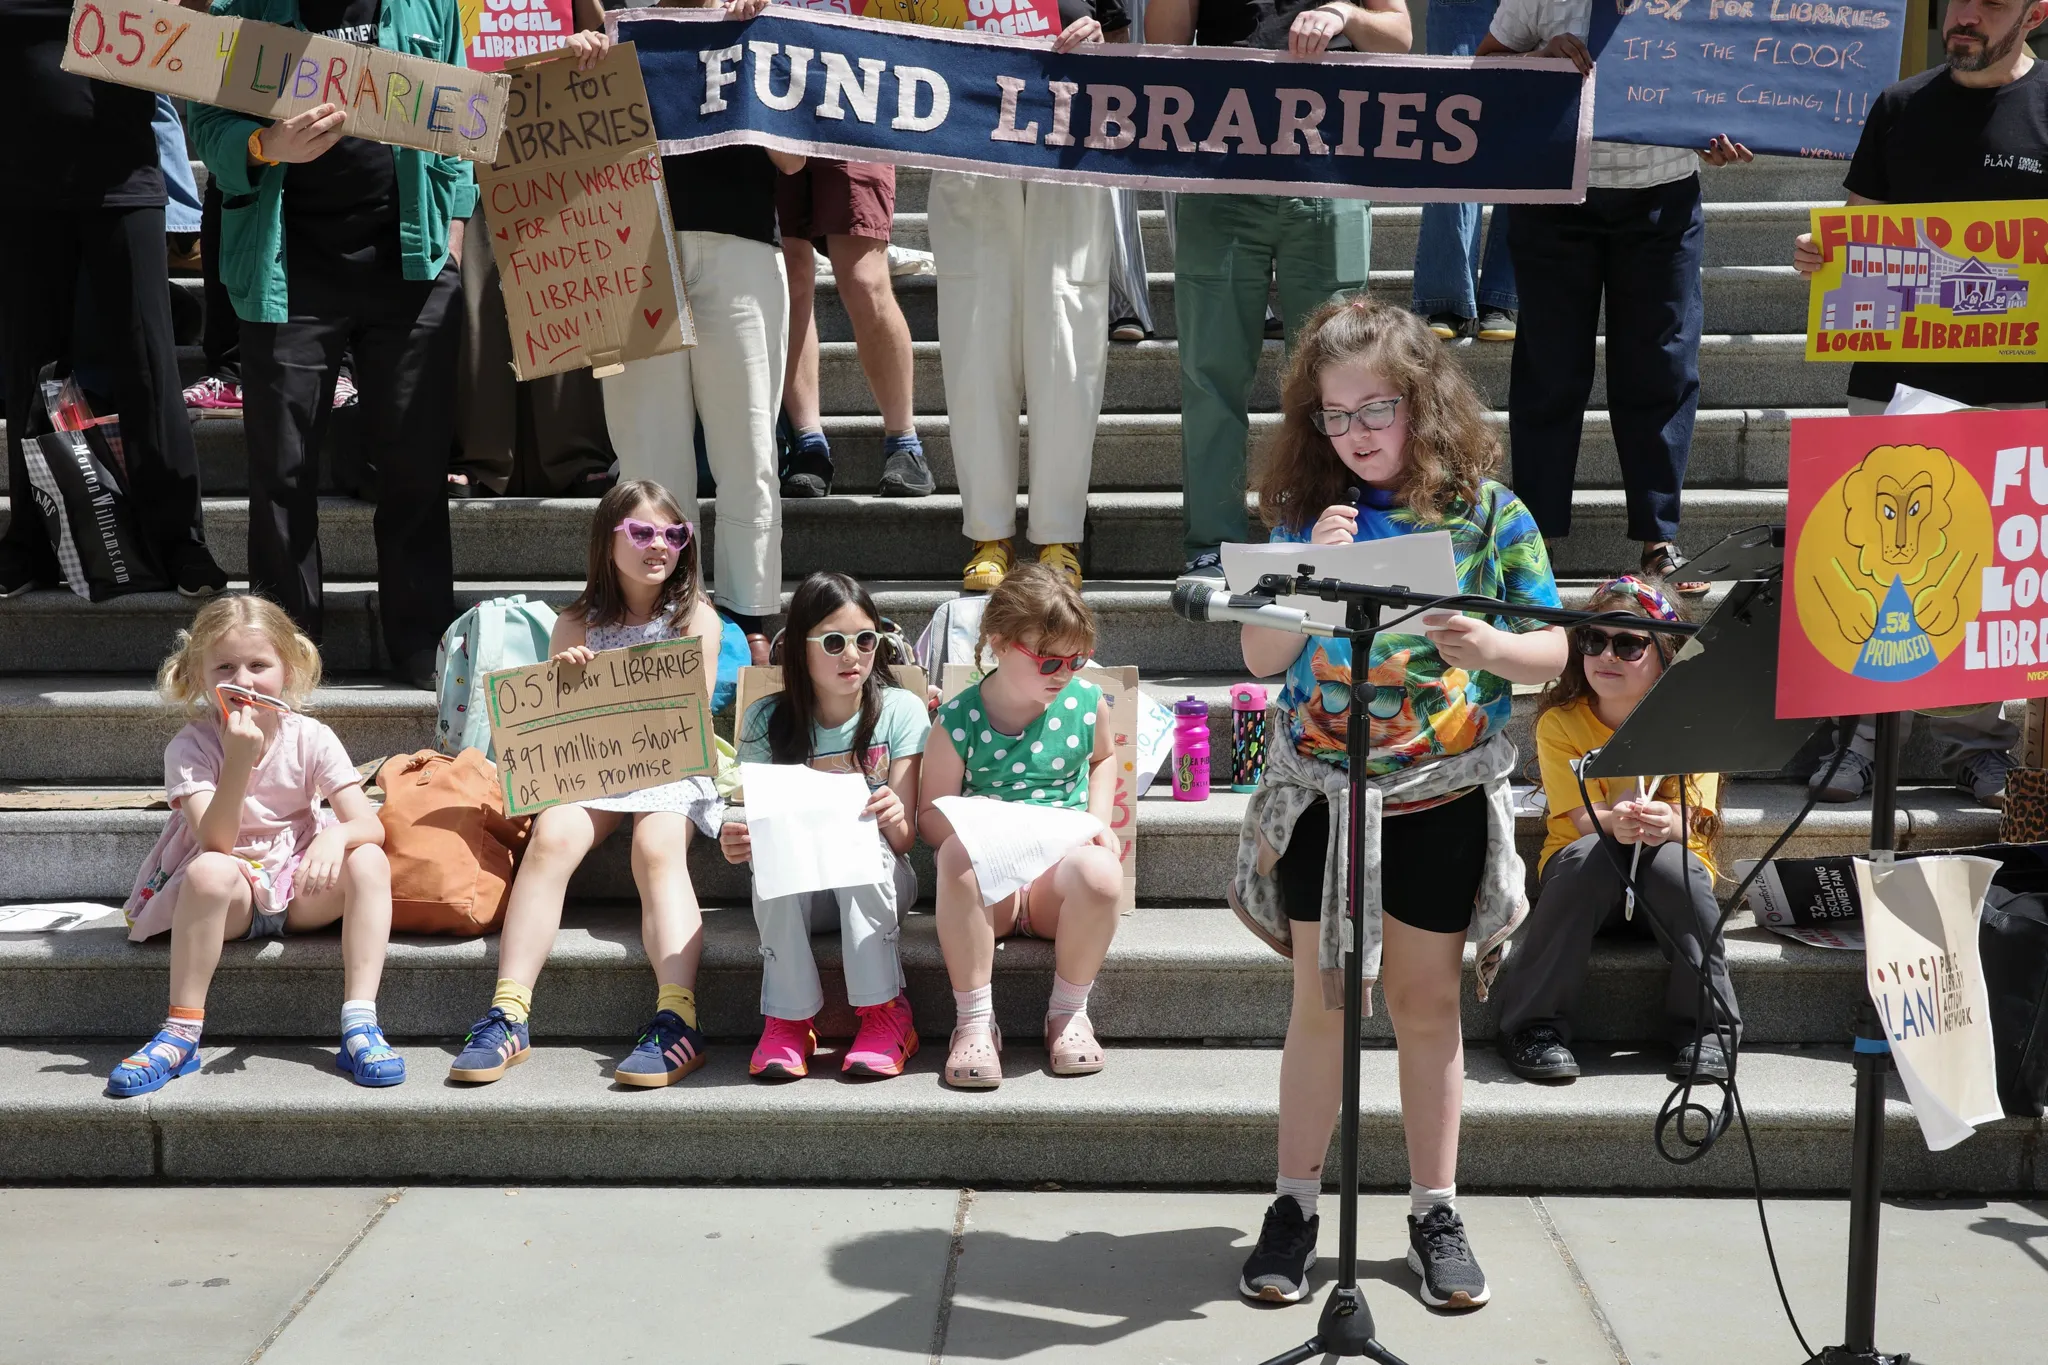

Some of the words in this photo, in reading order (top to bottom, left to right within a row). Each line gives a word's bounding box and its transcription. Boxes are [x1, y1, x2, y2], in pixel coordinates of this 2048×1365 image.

[479, 11, 562, 33] LOCAL
[1770, 0, 1891, 29] LIBRARIES
[1623, 37, 1678, 61] IT'S
[1700, 42, 1737, 61] THE
[1753, 37, 1867, 70] FLOOR
[72, 3, 191, 72] 0.5%
[250, 44, 490, 141] LIBRARIES
[564, 70, 618, 102] for
[699, 40, 951, 132] FUND
[990, 74, 1483, 165] LIBRARIES
[1627, 86, 1670, 104] NOT
[1692, 88, 1727, 105] THE
[491, 103, 651, 171] LIBRARIES
[1983, 158, 2014, 168] PLAN
[491, 170, 570, 214] CUNY
[574, 155, 662, 197] WORKERS
[514, 217, 550, 244] FOR
[558, 200, 624, 235] FULLY
[1819, 214, 1953, 263] FUND
[1963, 216, 2048, 265] OUR
[510, 239, 612, 286] FUNDED
[526, 265, 653, 318] LIBRARIES
[1816, 331, 1892, 353] LOCAL
[1901, 316, 2040, 350] LIBRARIES
[1880, 611, 1910, 634] .5%
[1863, 634, 1930, 667] PROMISED
[498, 666, 572, 714] 0.5%
[580, 671, 601, 689] for
[610, 649, 703, 688] LIBRARIES
[502, 743, 546, 774] $97
[554, 732, 623, 768] million
[631, 715, 694, 754] short
[520, 779, 541, 805] of
[554, 772, 586, 795] his
[598, 758, 672, 795] promise
[1814, 866, 1841, 917] OSCILLATING
[1829, 869, 1844, 887] FAN
[1756, 885, 1775, 912] Comfort
[1809, 905, 1828, 918] 32
[1837, 887, 1855, 917] TOWER
[1888, 961, 1901, 985] Y
[1918, 957, 1930, 981] C
